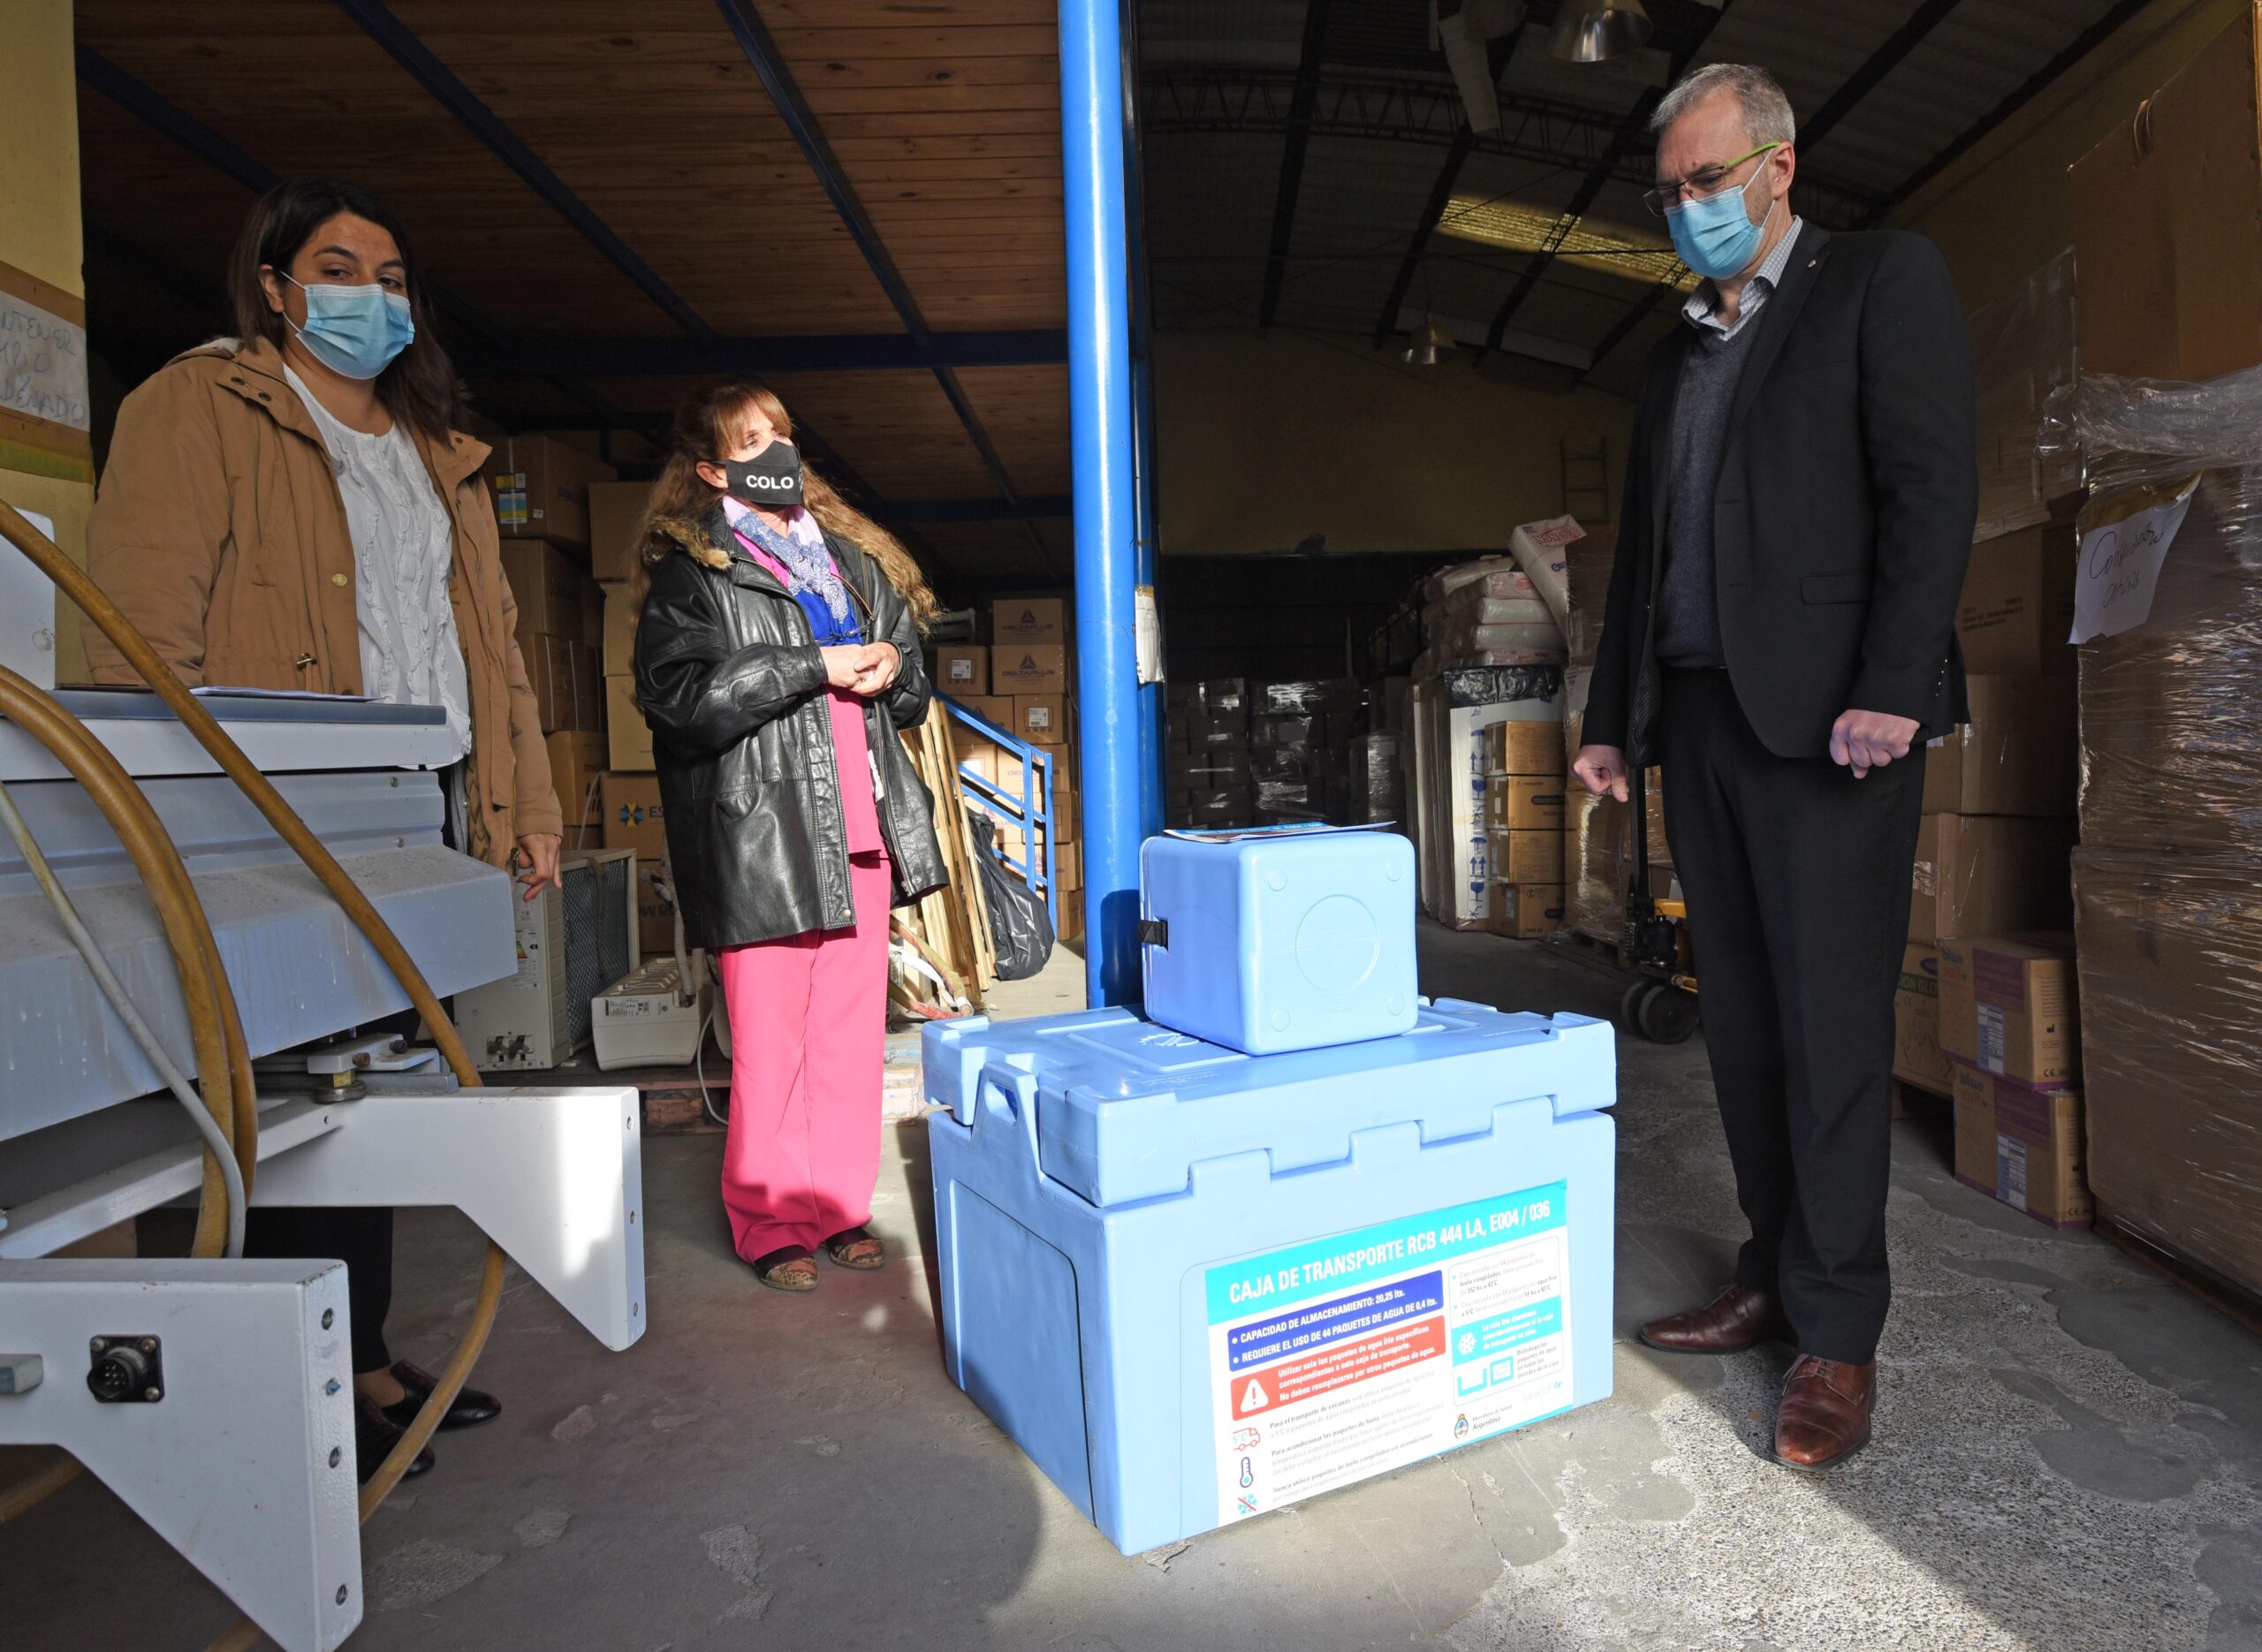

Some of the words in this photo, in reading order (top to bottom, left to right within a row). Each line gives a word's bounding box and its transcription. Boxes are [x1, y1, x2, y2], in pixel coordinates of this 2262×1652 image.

[746, 474, 794, 489] COLO
[1229, 1274, 1275, 1305] CAJA
[1279, 1267, 1300, 1292] DE
[1303, 1239, 1405, 1284] TRANSPORTE
[1407, 1231, 1437, 1256] RCB
[1440, 1224, 1463, 1247] 444
[1466, 1216, 1488, 1241] LA,
[1490, 1208, 1519, 1233] E004
[1521, 1205, 1528, 1226] /
[1530, 1200, 1551, 1222] 036
[1241, 1322, 1287, 1344] CAPACIDAD
[1288, 1318, 1300, 1330] DE
[1301, 1296, 1375, 1326] ALMACENAMIENTO:
[1376, 1291, 1393, 1305] 20,25
[1394, 1288, 1405, 1299] lts.
[1242, 1343, 1281, 1363] REQUIERE
[1283, 1339, 1292, 1351] EL
[1294, 1334, 1309, 1347] USO
[1311, 1330, 1321, 1342] DE
[1323, 1328, 1332, 1338] 44
[1332, 1315, 1370, 1337] PAQUETES
[1372, 1313, 1382, 1323] DE
[1384, 1306, 1404, 1321] AGUA
[1406, 1303, 1415, 1314] DE
[1416, 1300, 1426, 1312] 0,4
[1427, 1296, 1438, 1307] lts.
[1472, 1415, 1501, 1433] Argentina
